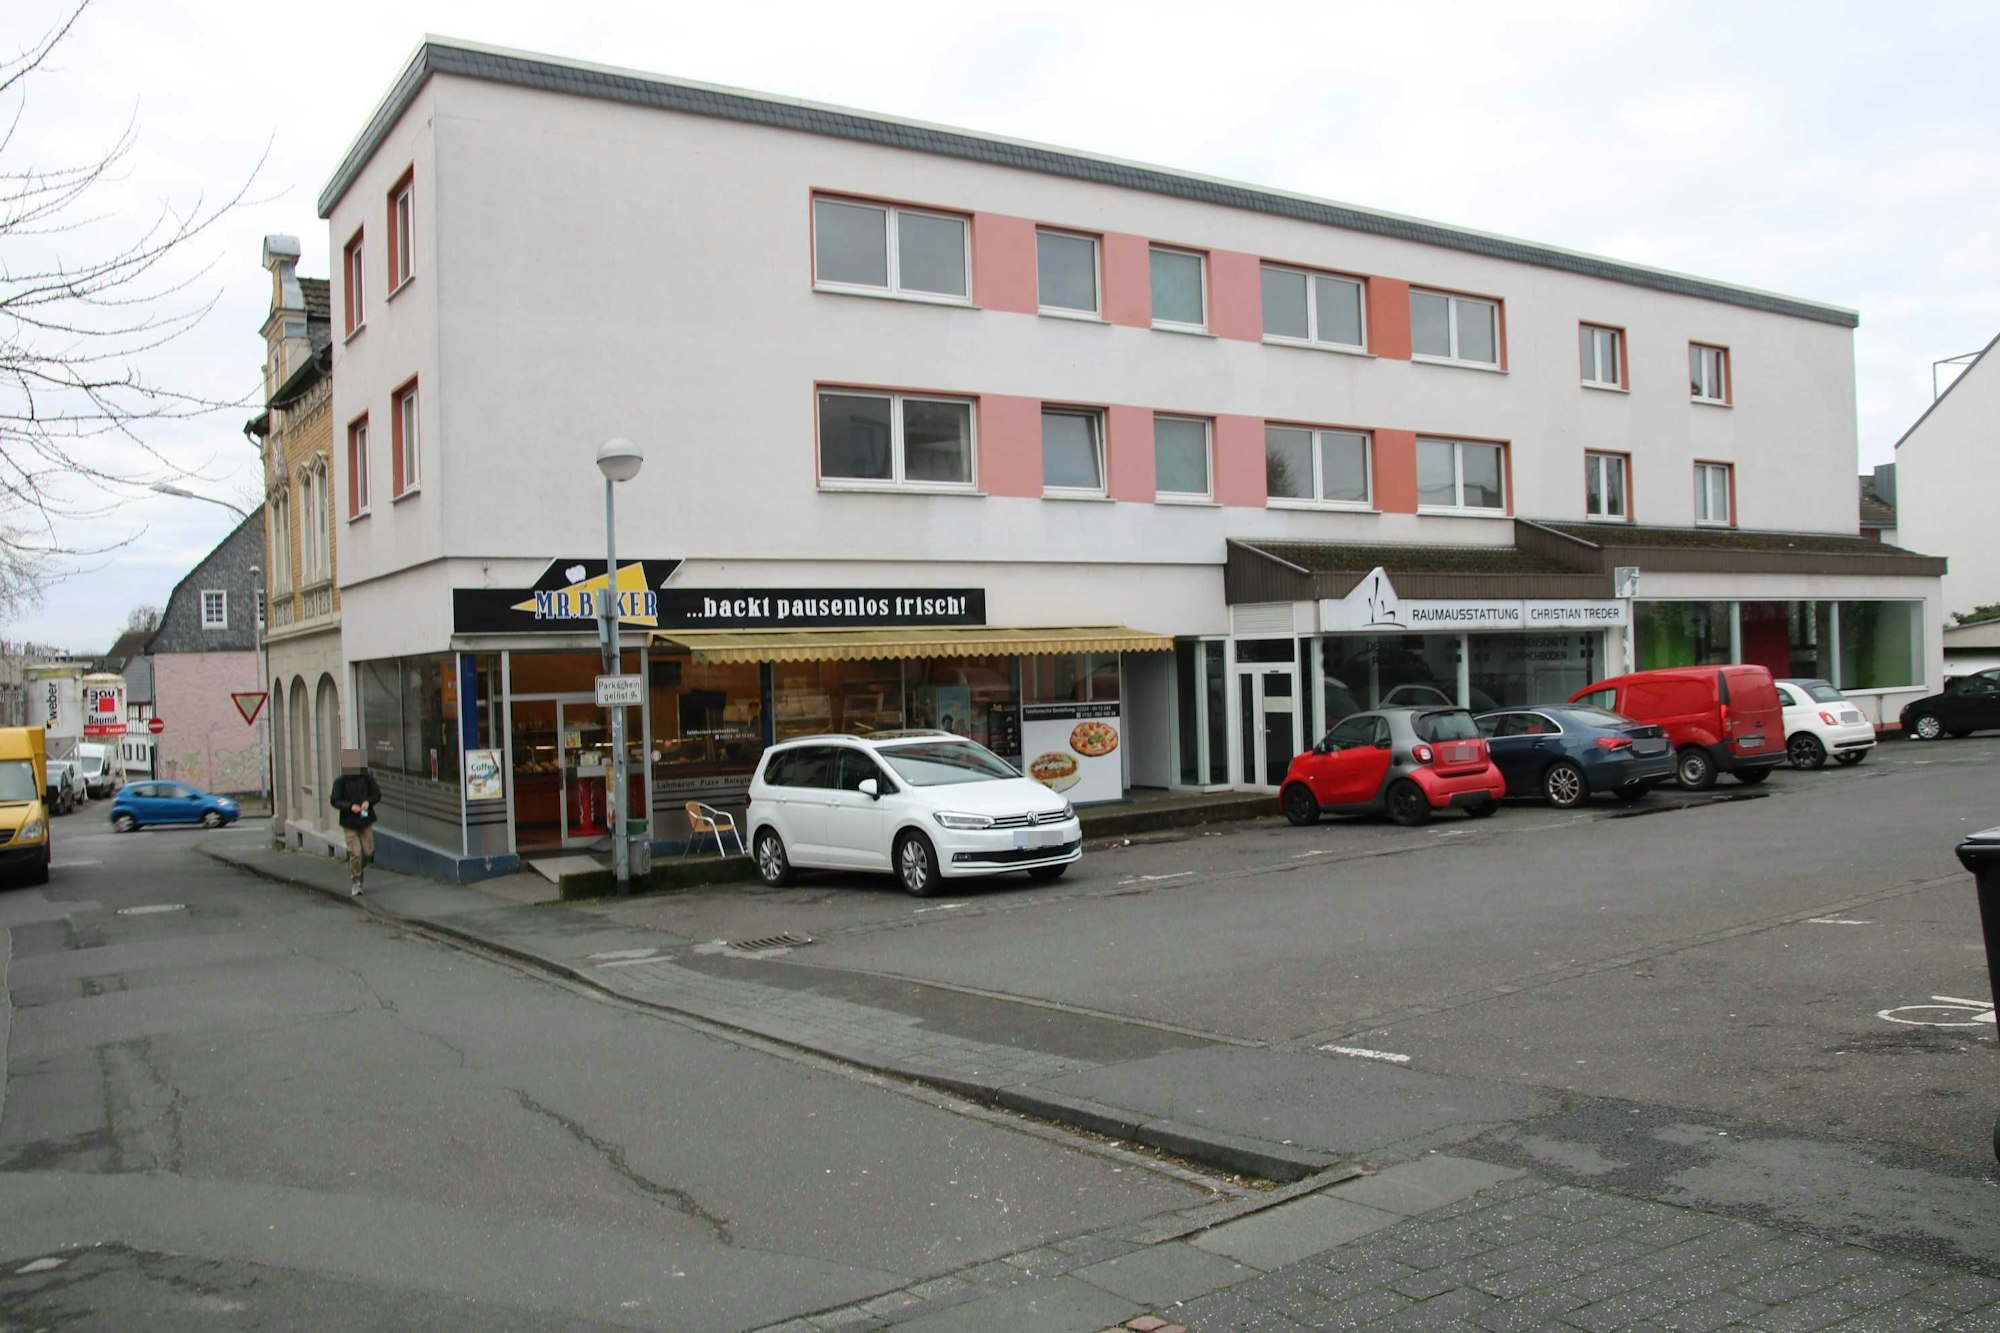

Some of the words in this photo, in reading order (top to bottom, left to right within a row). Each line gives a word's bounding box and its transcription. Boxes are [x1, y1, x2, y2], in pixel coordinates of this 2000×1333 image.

[534, 590, 658, 619] MR.BKER
[686, 596, 770, 618] ...backt
[777, 596, 889, 619] pausenlos
[895, 595, 966, 616] frisch!
[1412, 608, 1519, 621] RAUMAUSSTATTUNG
[1530, 608, 1581, 620] CHRISTIAN
[1584, 607, 1620, 619] TREDER
[598, 681, 640, 690] Parkschein
[46, 682, 58, 720] weber
[88, 715, 118, 725] Baumit
[471, 763, 496, 771] Coffee
